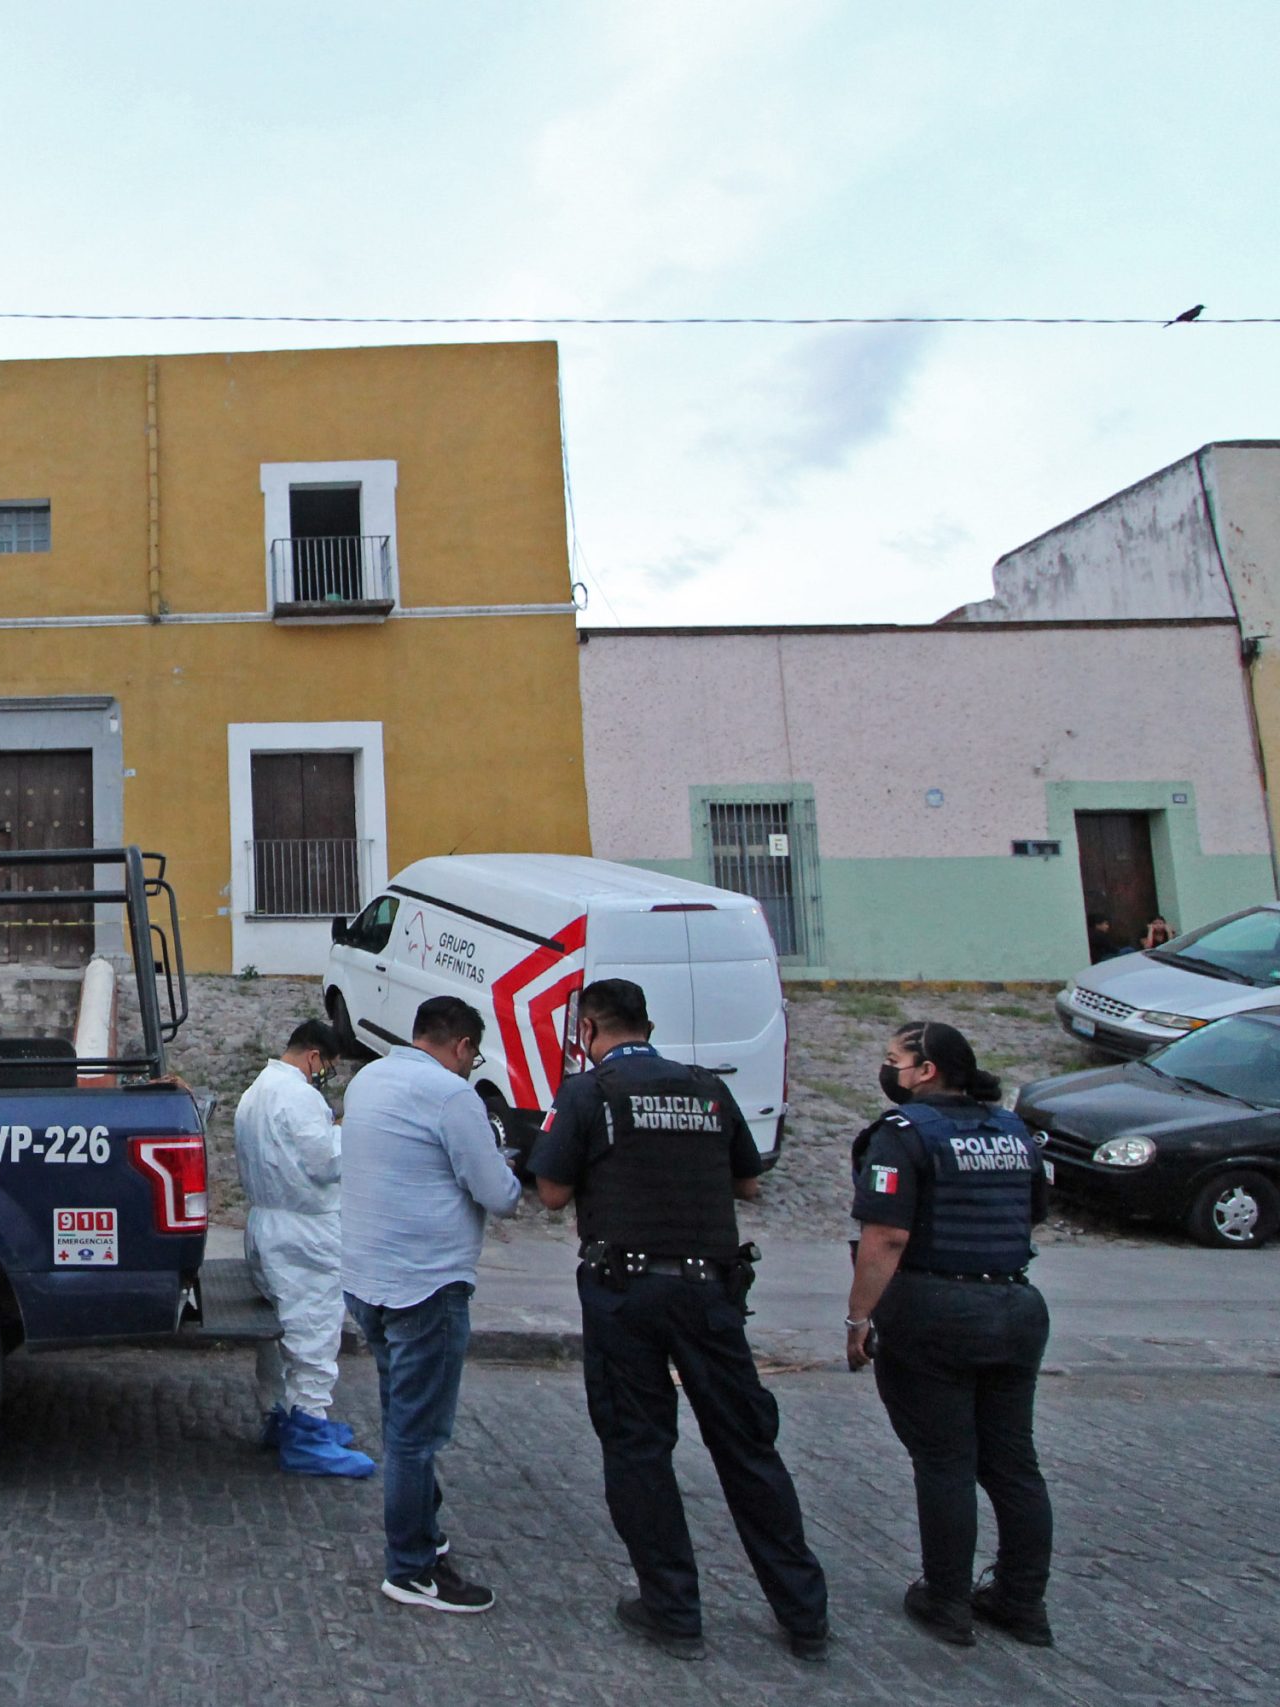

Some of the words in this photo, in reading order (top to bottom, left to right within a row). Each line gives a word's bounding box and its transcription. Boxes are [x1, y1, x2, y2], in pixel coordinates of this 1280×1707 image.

[439, 932, 476, 959] GRUPO
[434, 951, 485, 984] AFFINITAS
[632, 1112, 722, 1133] MUNICIPAL
[949, 1134, 1029, 1156] POLICÍA
[955, 1153, 1032, 1172] MUNICIPAL
[59, 1212, 111, 1230] 911
